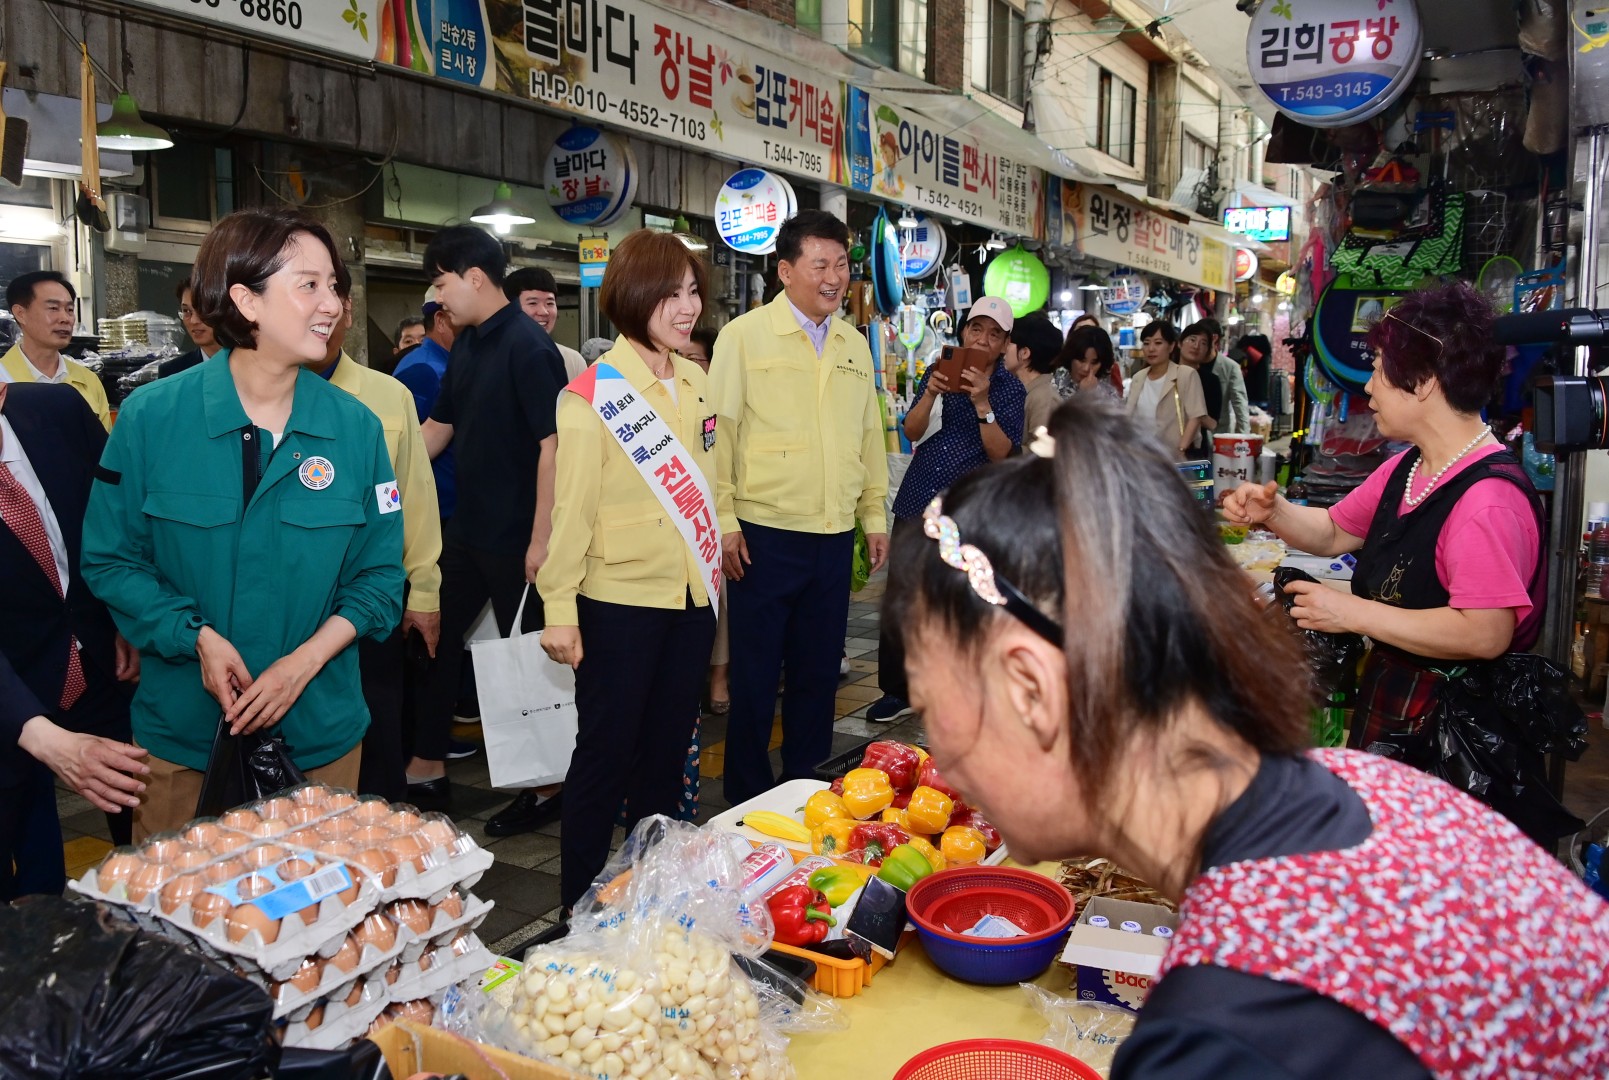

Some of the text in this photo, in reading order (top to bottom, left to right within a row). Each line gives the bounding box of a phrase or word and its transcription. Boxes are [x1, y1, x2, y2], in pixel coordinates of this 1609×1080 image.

[441, 21, 476, 51] 반송2동
[1260, 16, 1400, 68] 김희공방
[653, 23, 716, 109] 장날
[755, 64, 834, 146] 김포커피숍
[1280, 81, 1372, 101] T.543-3145
[553, 149, 607, 178] 날마다
[763, 140, 822, 173] T.544-7995
[899, 120, 996, 200] 아이들팬시
[720, 201, 777, 231] 김포커피숍
[915, 185, 983, 218] T.542-4521
[730, 231, 769, 245] T.544-7995
[599, 392, 636, 421] 해운대
[615, 410, 657, 443] 장바구니
[653, 454, 718, 564] 전통시장
